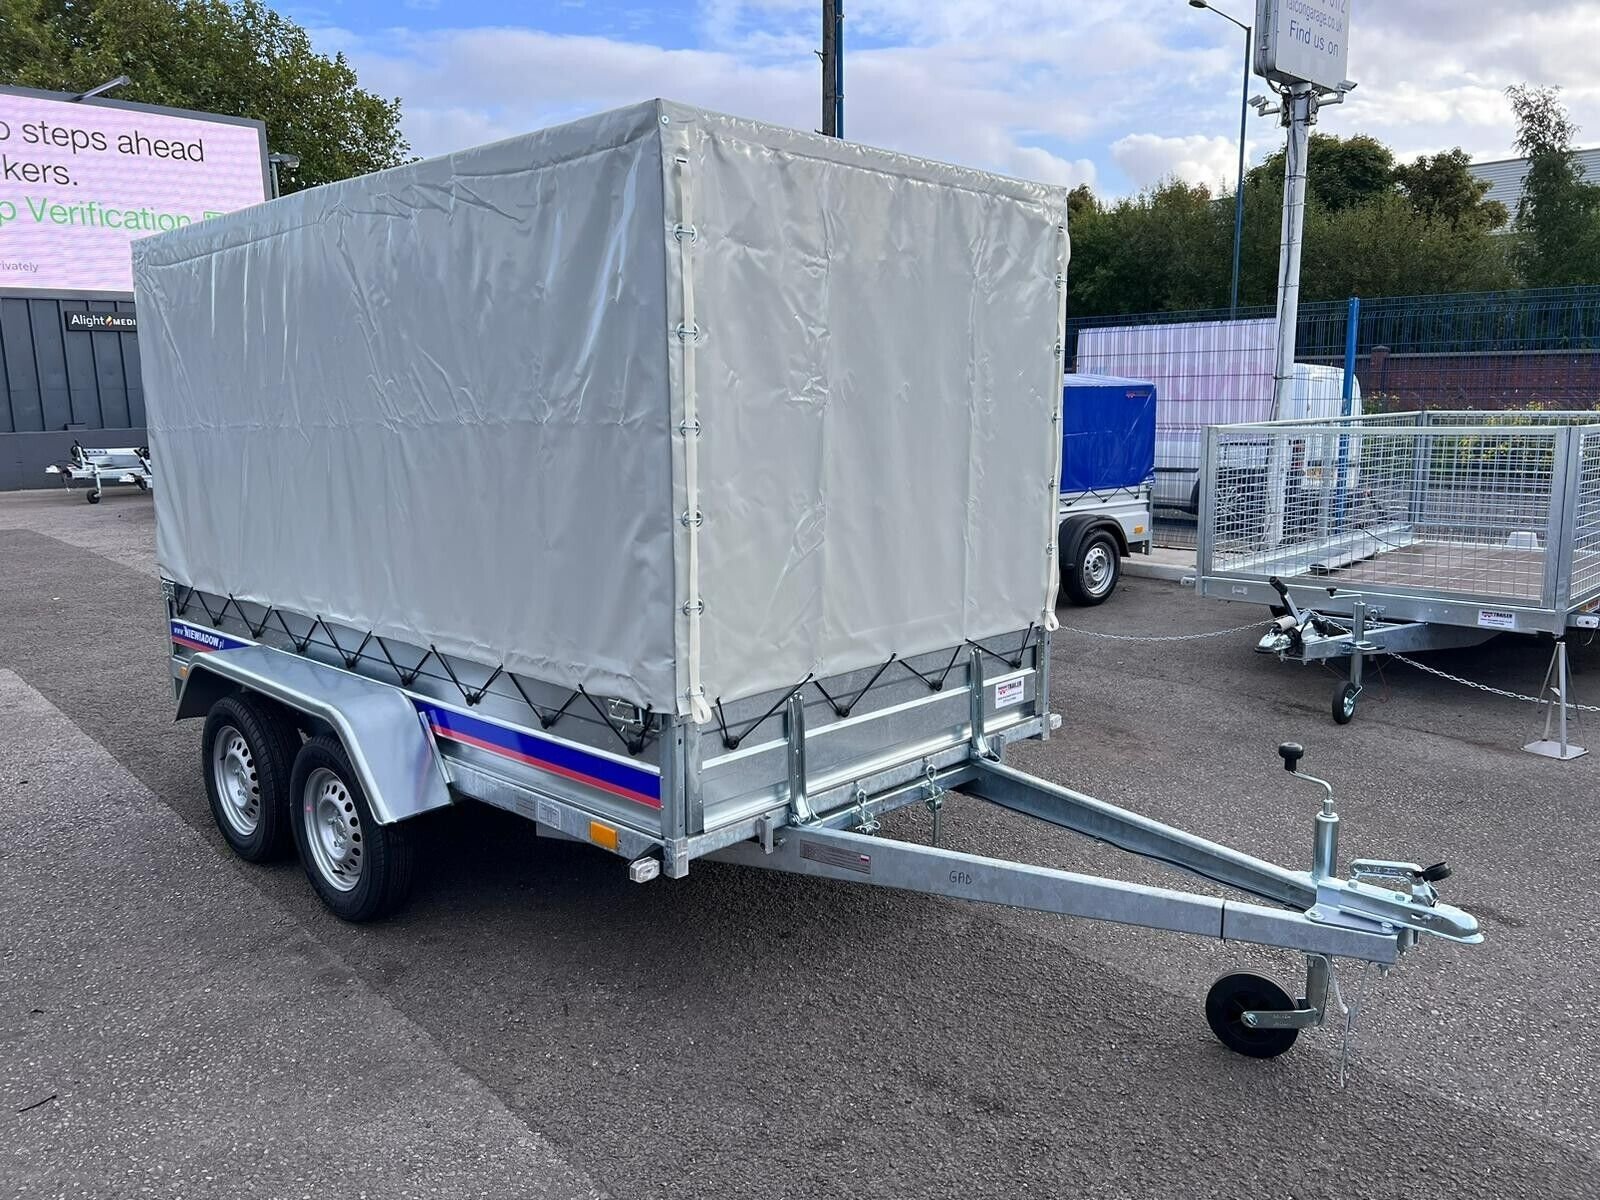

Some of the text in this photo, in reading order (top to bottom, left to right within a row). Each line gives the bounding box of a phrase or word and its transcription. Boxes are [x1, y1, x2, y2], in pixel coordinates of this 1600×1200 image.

[1289, 19, 1339, 57] Find us on
[22, 120, 107, 154] steps
[117, 129, 204, 162] ahead
[24, 196, 191, 231] Verification
[0, 260, 39, 273] ivately
[71, 314, 105, 328] Alight
